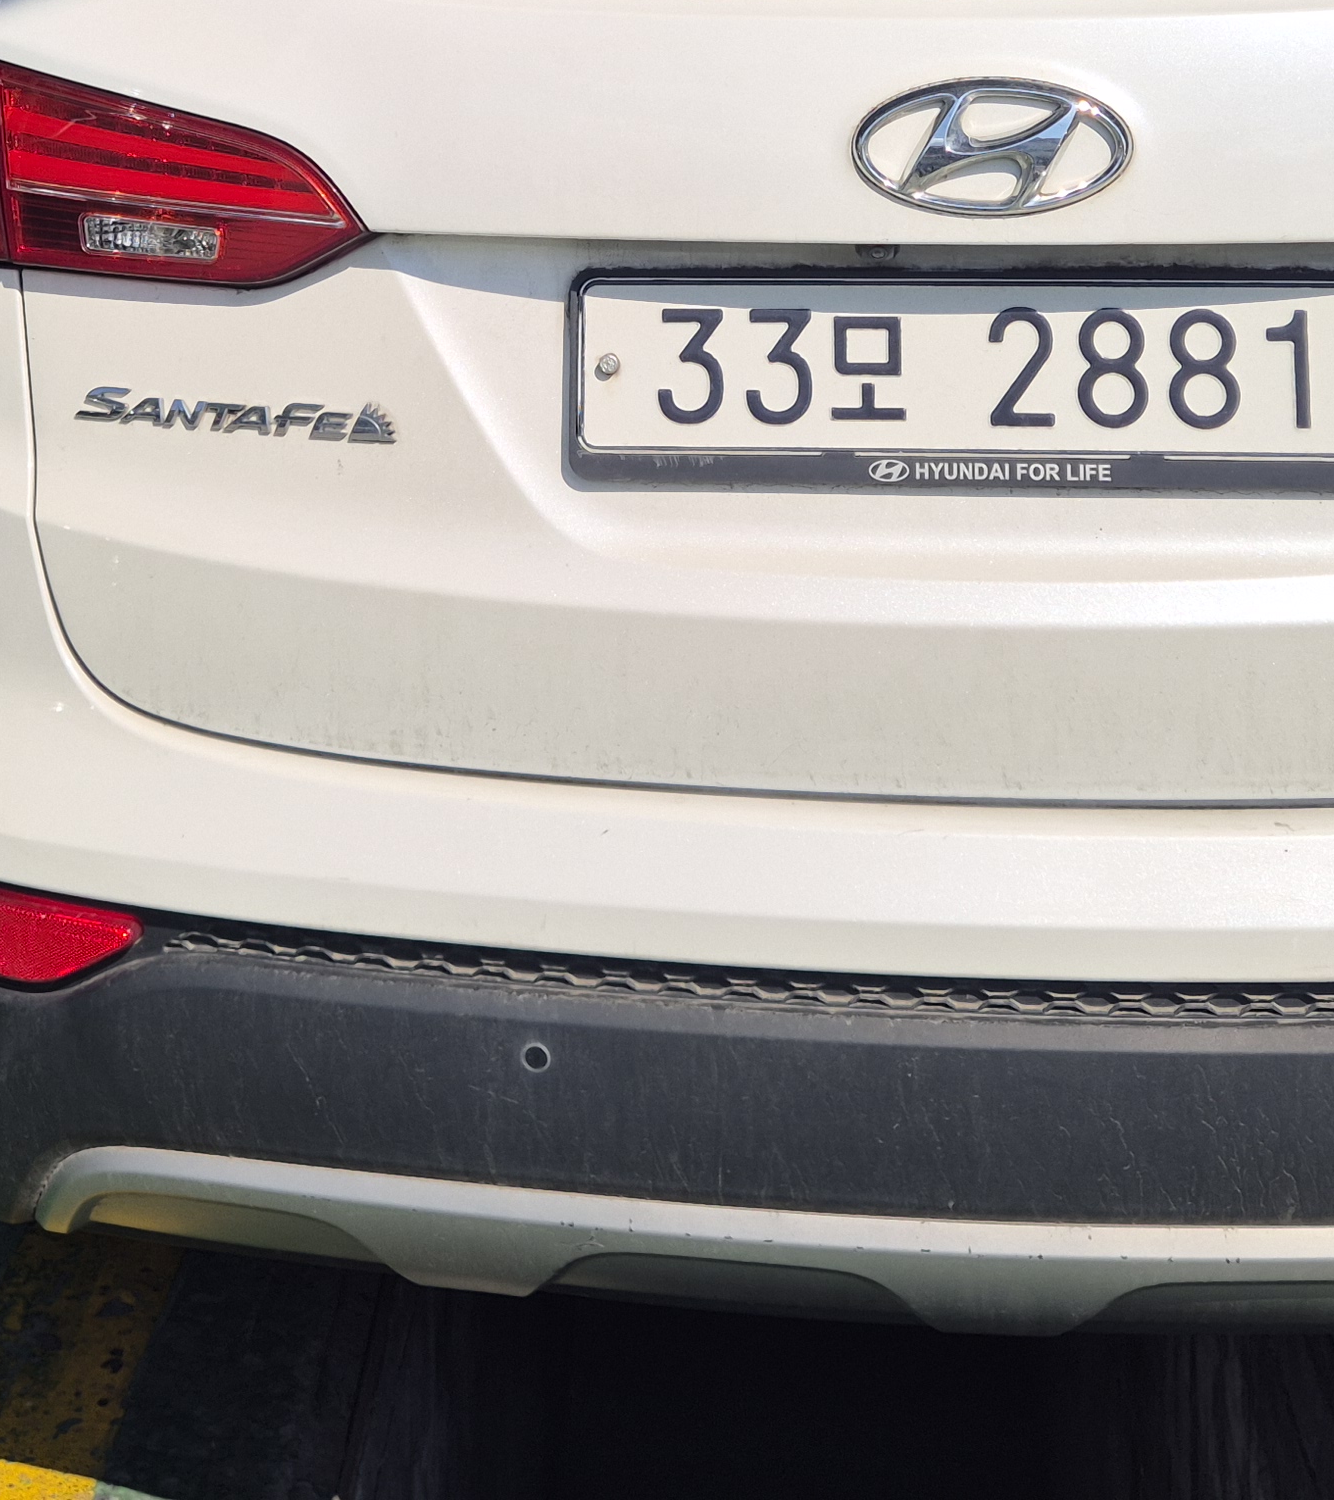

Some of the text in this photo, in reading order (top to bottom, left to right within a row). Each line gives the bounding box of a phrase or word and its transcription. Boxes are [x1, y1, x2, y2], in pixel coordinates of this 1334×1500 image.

[656, 307, 1312, 430] 33모 2881
[914, 462, 1112, 482] HYUNDAI FOR LIFE
